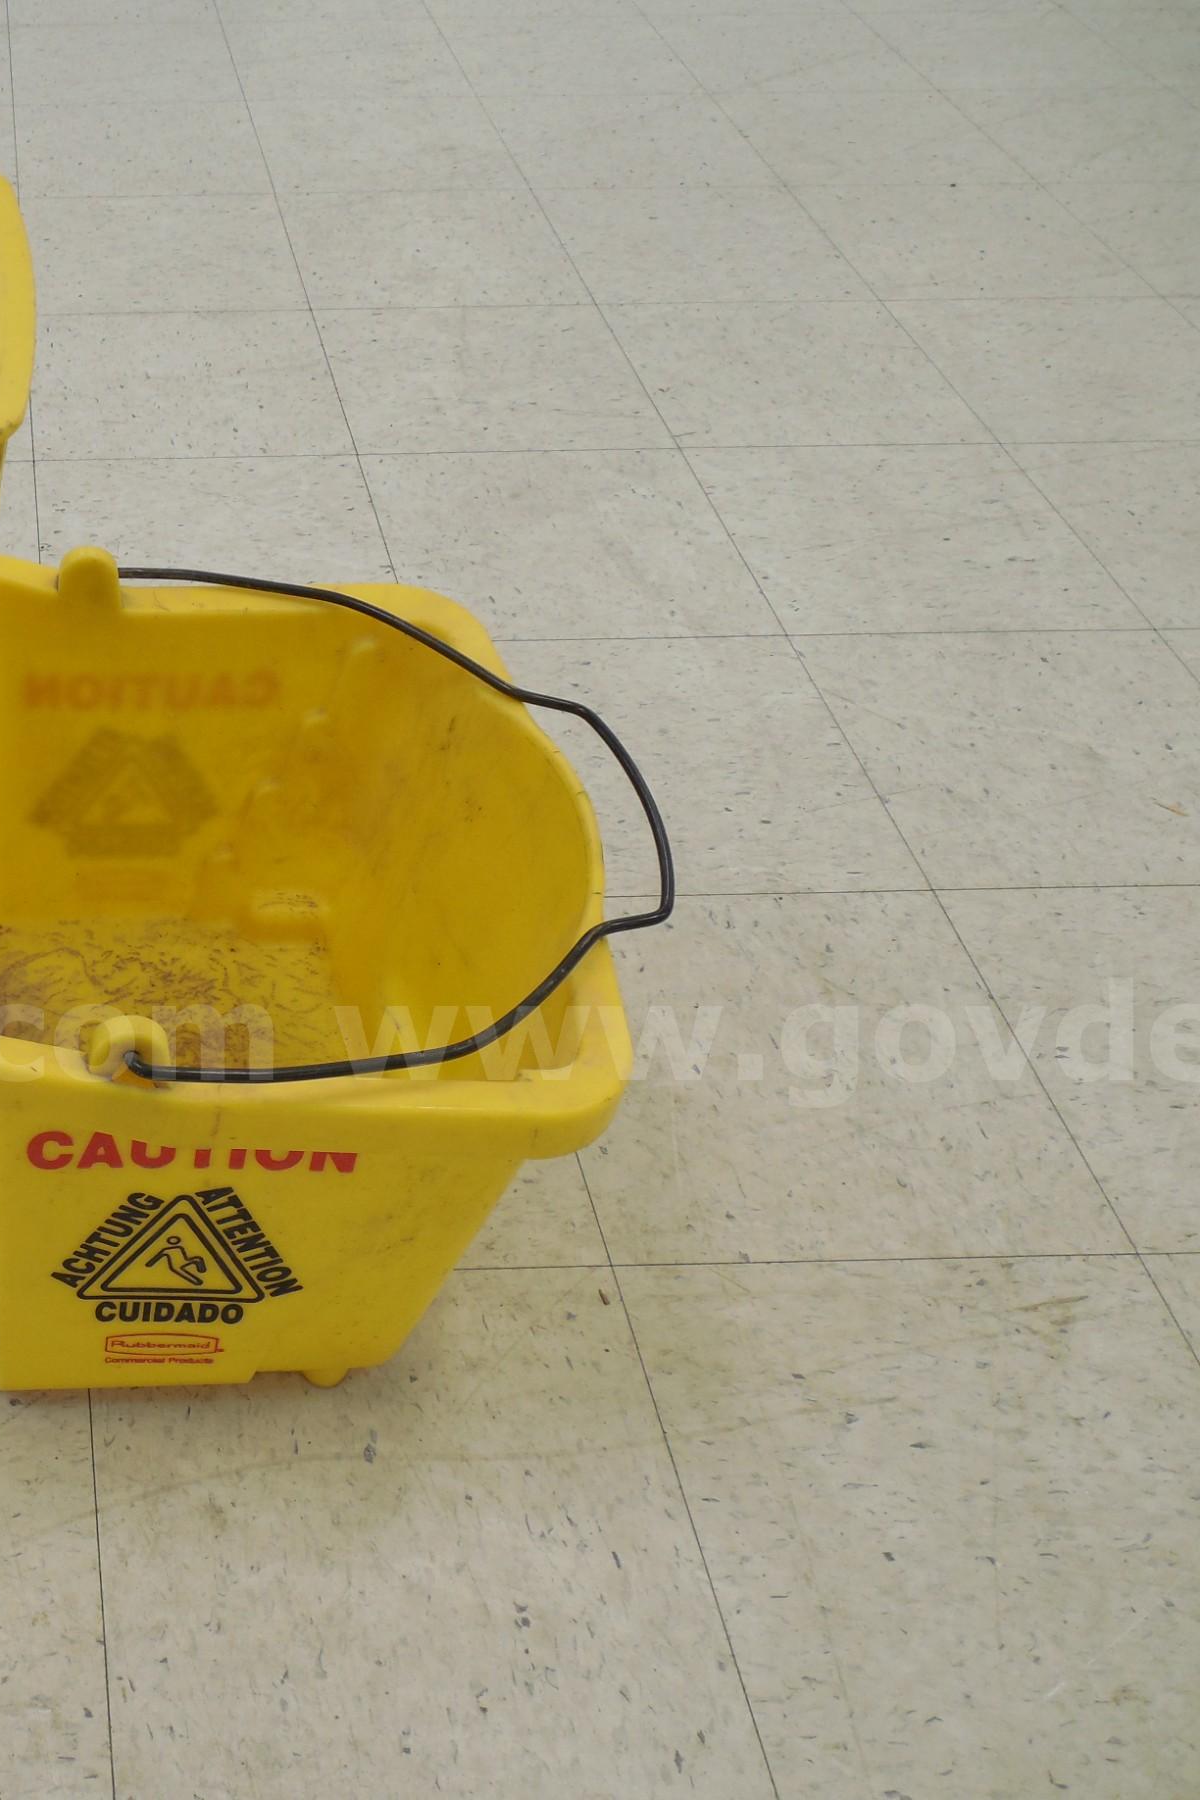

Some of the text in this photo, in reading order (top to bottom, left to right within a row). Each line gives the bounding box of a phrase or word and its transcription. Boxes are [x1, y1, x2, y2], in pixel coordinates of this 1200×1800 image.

[50, 1191, 164, 1288] ACHTUNG
[195, 1186, 304, 1298] ATTENTION
[95, 1301, 244, 1324] CUIDADO
[111, 1340, 212, 1350] Rubbermaid
